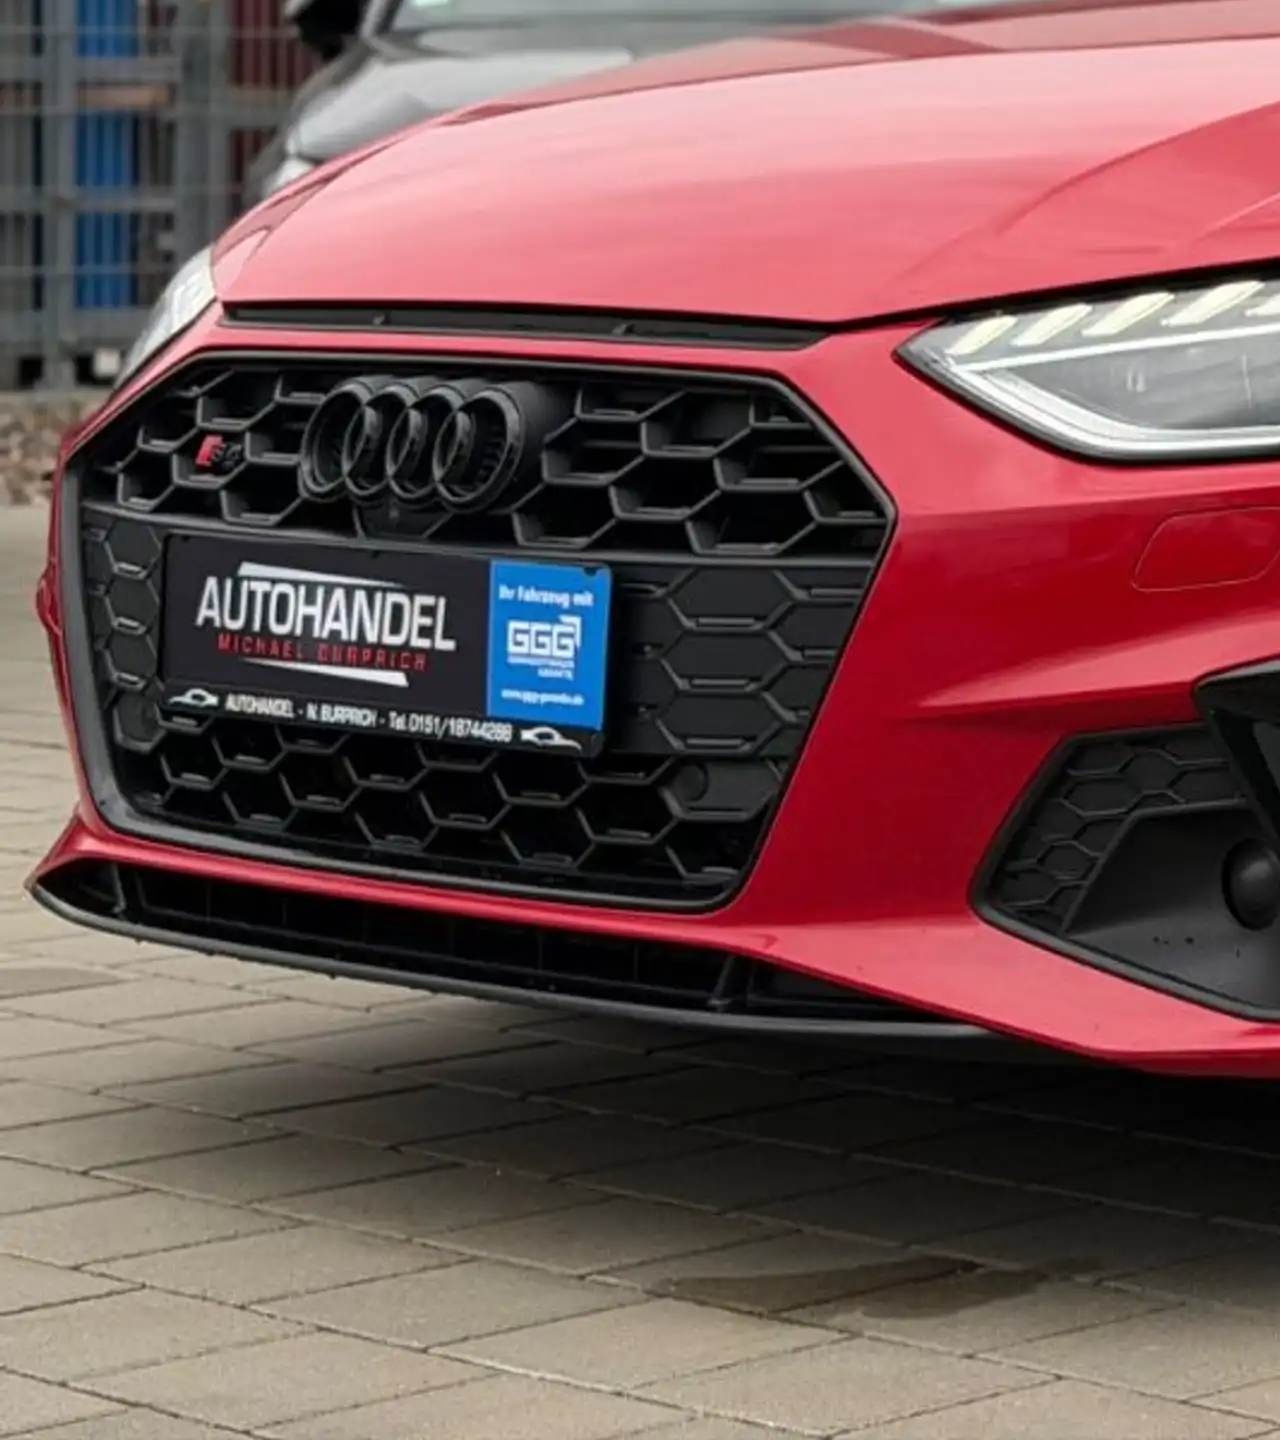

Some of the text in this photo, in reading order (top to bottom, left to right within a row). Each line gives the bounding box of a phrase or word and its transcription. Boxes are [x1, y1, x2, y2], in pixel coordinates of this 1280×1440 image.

[194, 575, 457, 652] AUTOHANDEL
[217, 632, 304, 659] MICHAEL
[507, 619, 576, 659] GGG
[225, 692, 295, 720] AUTOHANDEL
